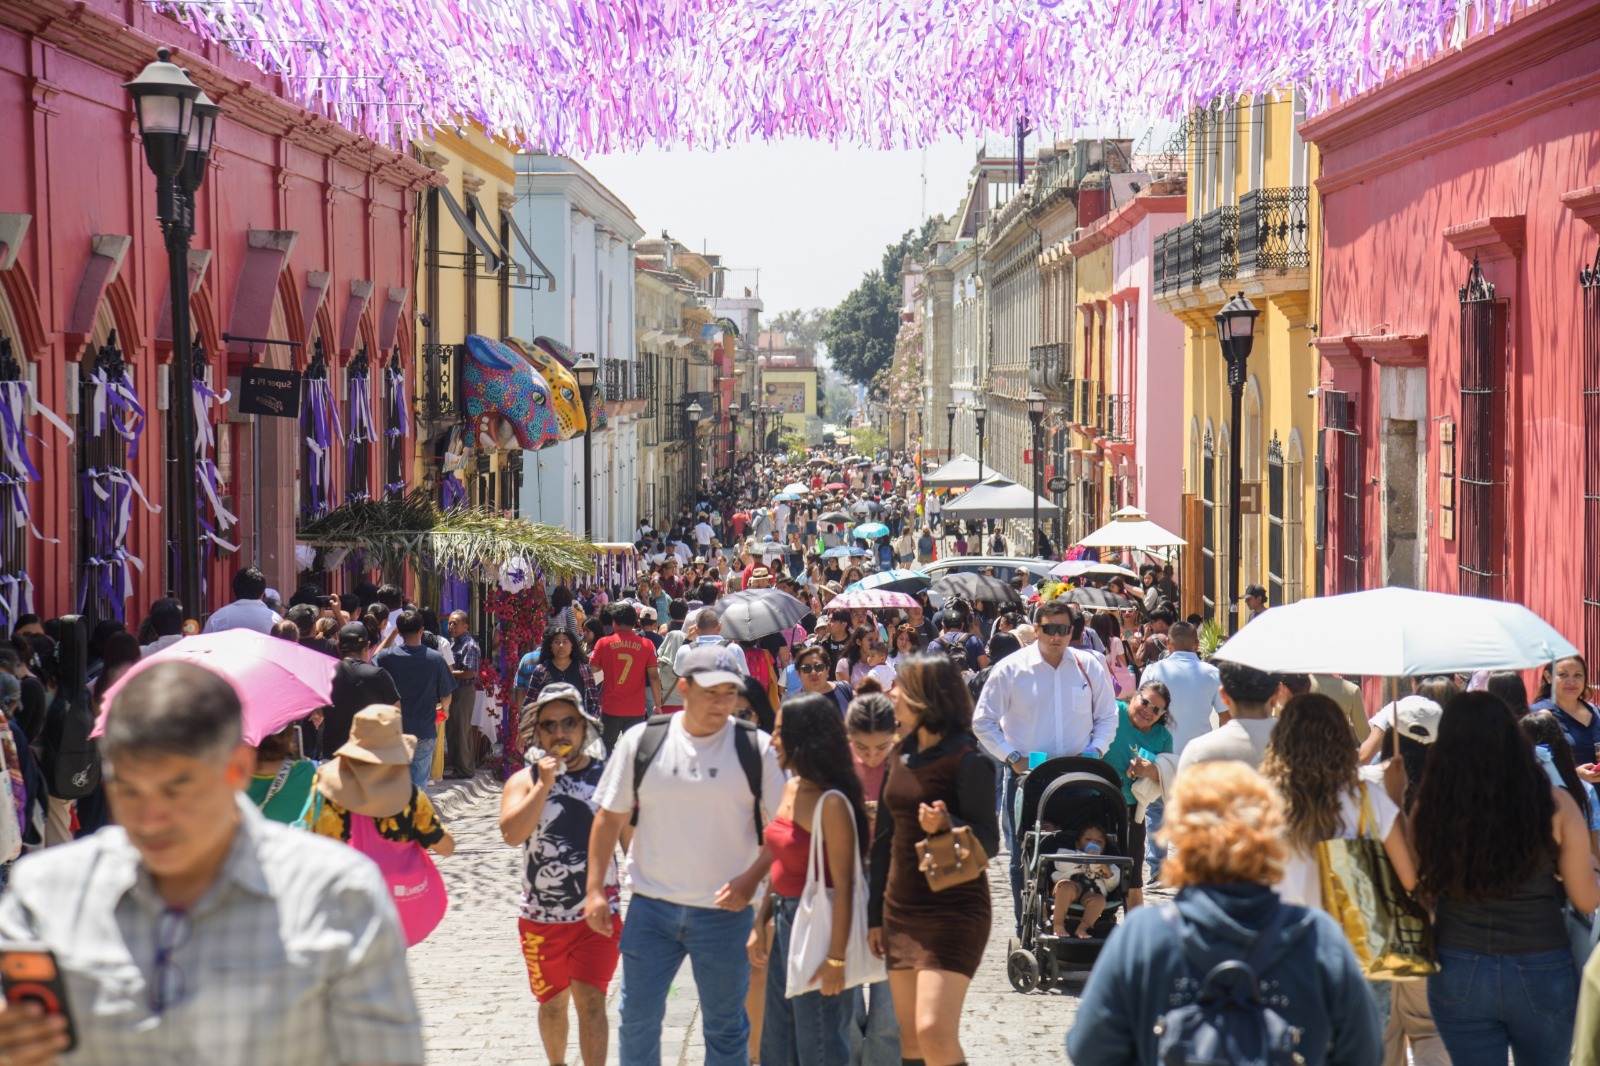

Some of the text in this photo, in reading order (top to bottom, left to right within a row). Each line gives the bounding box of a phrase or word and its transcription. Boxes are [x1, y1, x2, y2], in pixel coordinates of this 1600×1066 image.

[609, 640, 642, 652] RONALDO
[617, 653, 634, 685] 7
[522, 931, 554, 996] Animal
